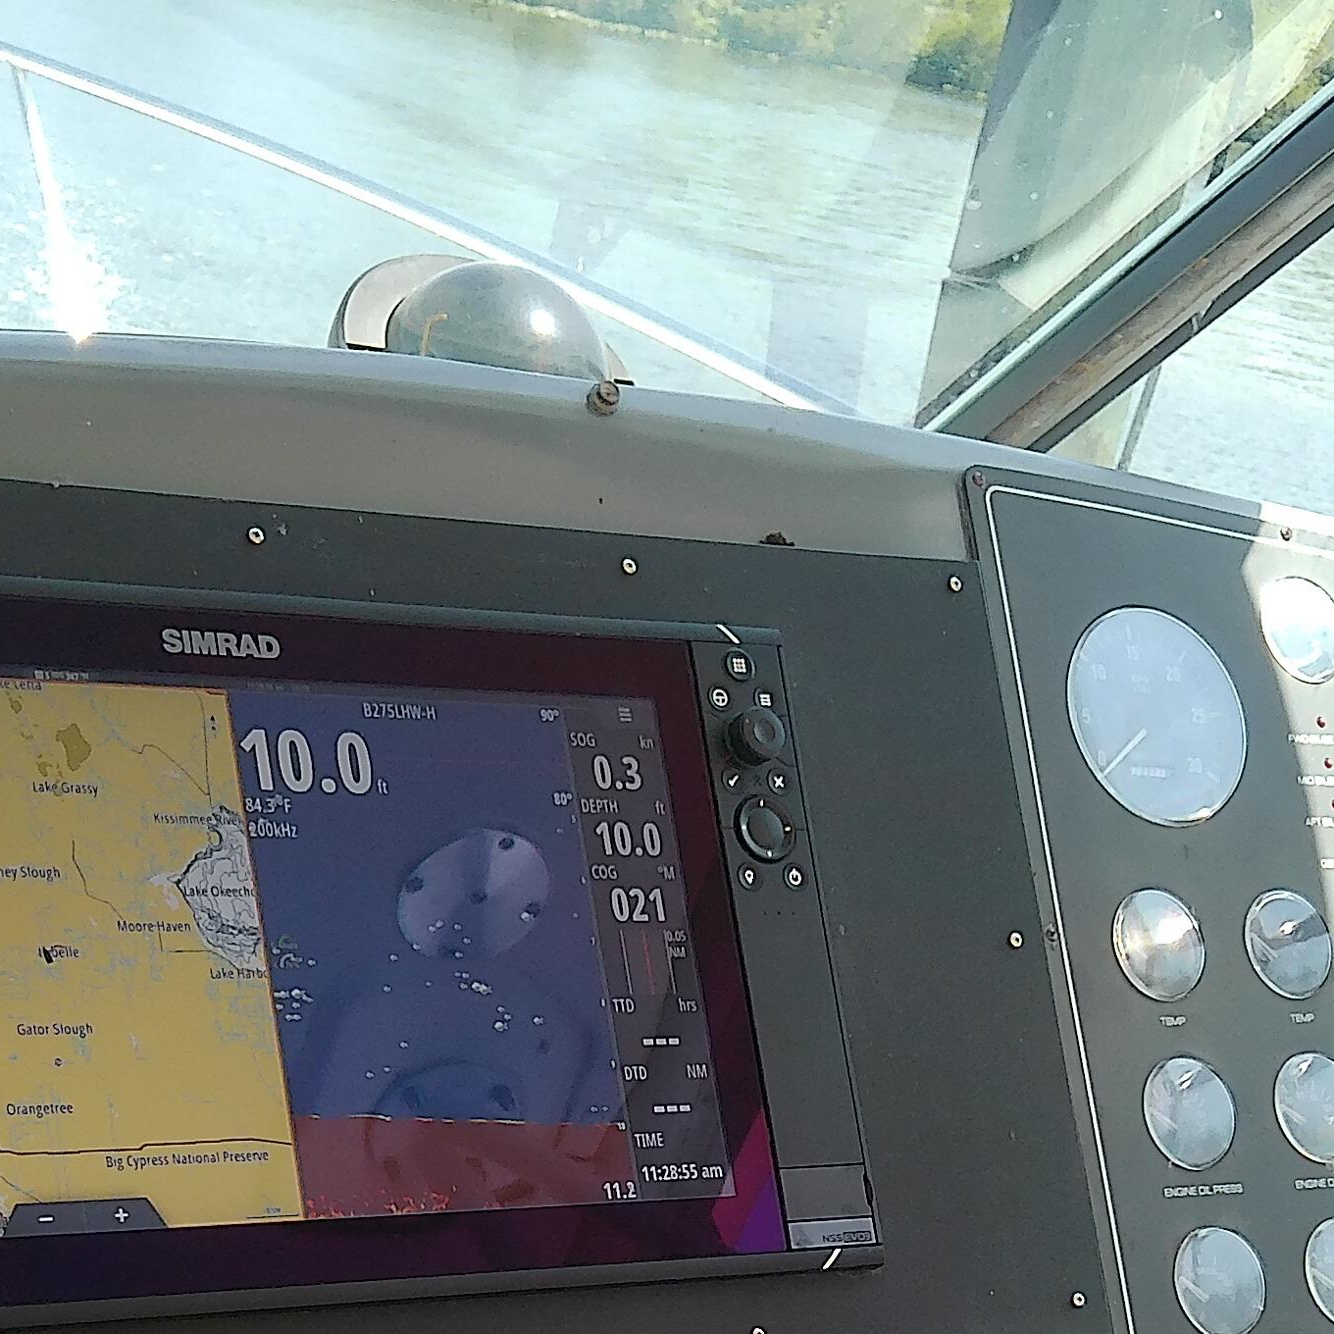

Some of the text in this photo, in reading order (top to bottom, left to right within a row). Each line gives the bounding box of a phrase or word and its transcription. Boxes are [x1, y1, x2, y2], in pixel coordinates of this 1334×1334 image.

[161, 628, 281, 659] SIMRAD
[569, 732, 654, 748] SOG kn
[239, 729, 388, 795] 10.0 ft
[593, 755, 642, 790] 0.3
[32, 782, 98, 798] Lake Grassy
[581, 799, 666, 815] DEPTH ft
[154, 813, 212, 825] Kissimmee
[249, 819, 298, 838] 200kHz
[596, 821, 662, 857] 10.0
[20, 866, 61, 882] Slough
[591, 864, 617, 880] COG
[184, 886, 208, 897] Lake
[611, 888, 666, 922] 021
[117, 920, 191, 932] Moore Haven
[210, 968, 234, 980] Lake
[612, 998, 635, 1013] TTD
[678, 998, 697, 1012] hrs
[1159, 1015, 1187, 1027] TEMP
[1289, 1012, 1315, 1024] TEMP
[17, 1023, 93, 1039] Gator Slough
[624, 1064, 708, 1080] DTD NM
[6, 1103, 74, 1118] Orangetree
[634, 1133, 665, 1148] TIME
[106, 1151, 269, 1171] Big Cypress National Preserve
[641, 1163, 724, 1182] 11:28:55 am
[602, 1182, 637, 1200] 11.2
[1164, 1182, 1243, 1198] ENGINE OIL PRESS
